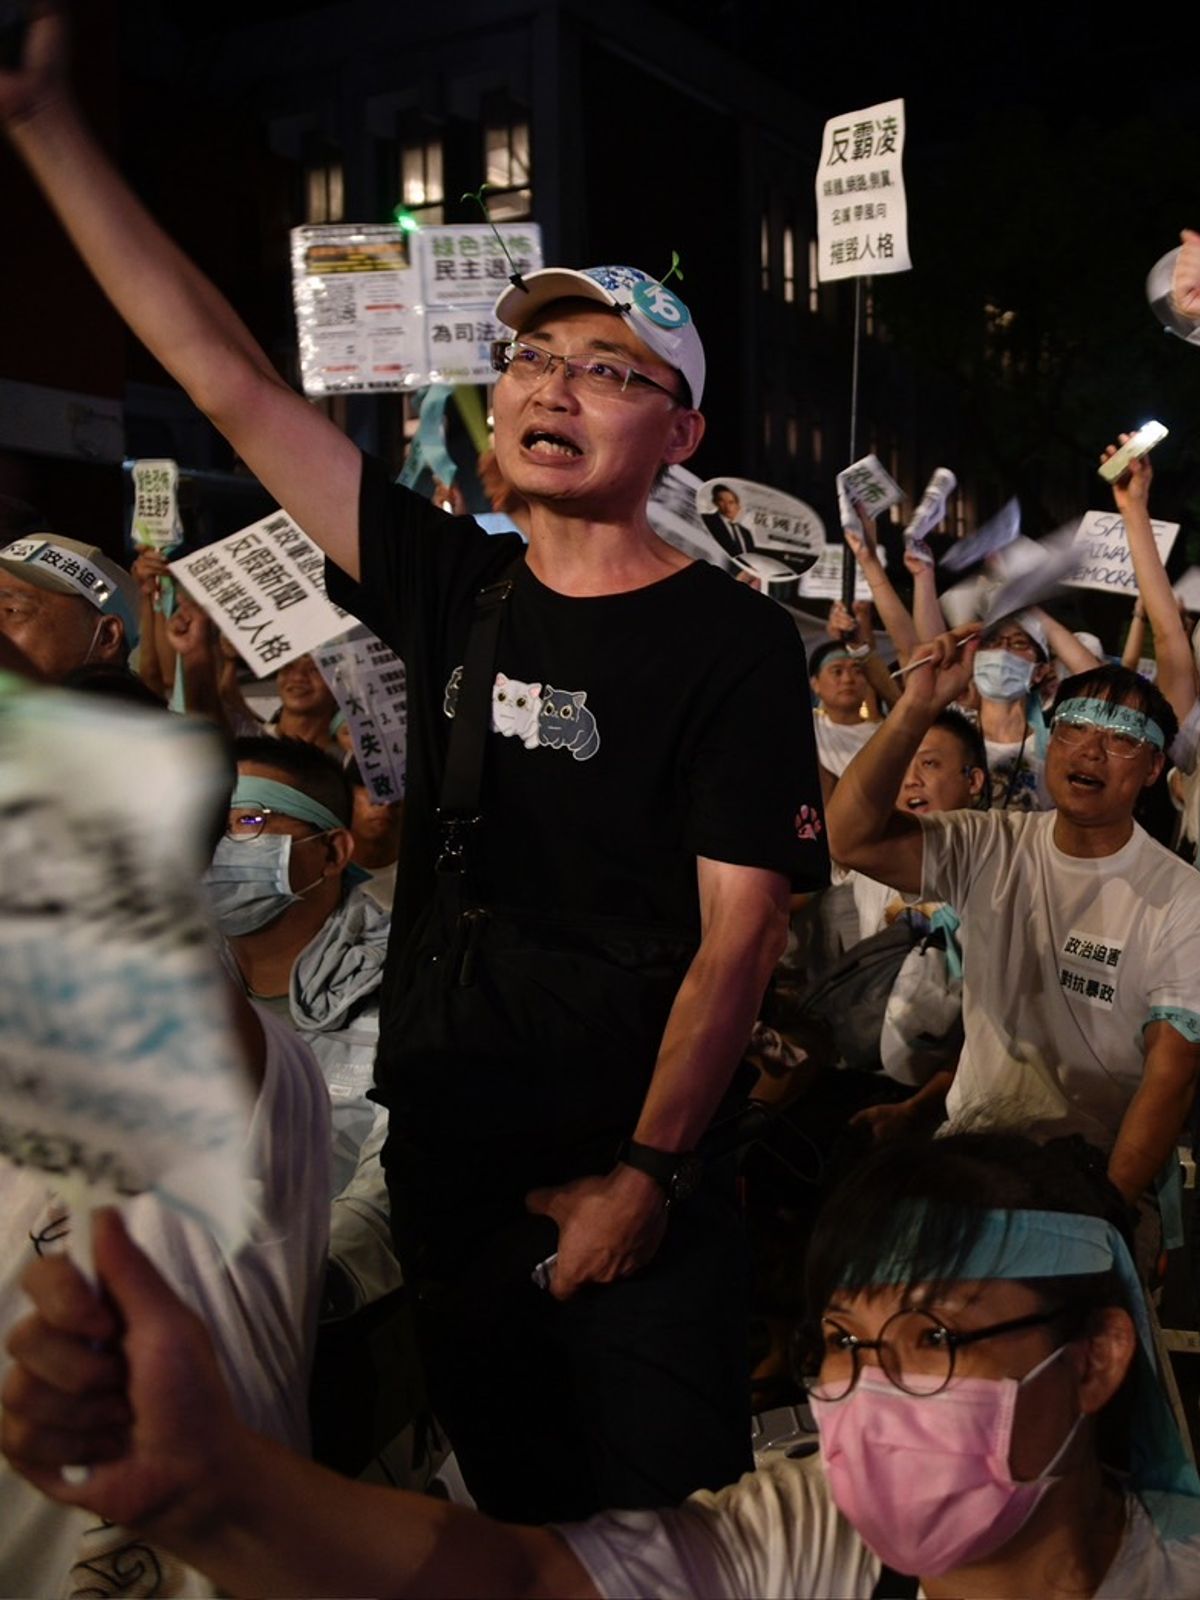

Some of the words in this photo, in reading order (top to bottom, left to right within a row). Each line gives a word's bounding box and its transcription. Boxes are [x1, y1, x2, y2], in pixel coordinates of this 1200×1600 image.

[826, 116, 898, 166] 反霸凌
[829, 233, 894, 266] 摧毀人格
[223, 533, 309, 612] 反假新聞
[185, 551, 292, 663] 造謠摧毀人格
[1064, 936, 1122, 967] 政治迫害
[1060, 969, 1115, 1004] 對抗暴政
